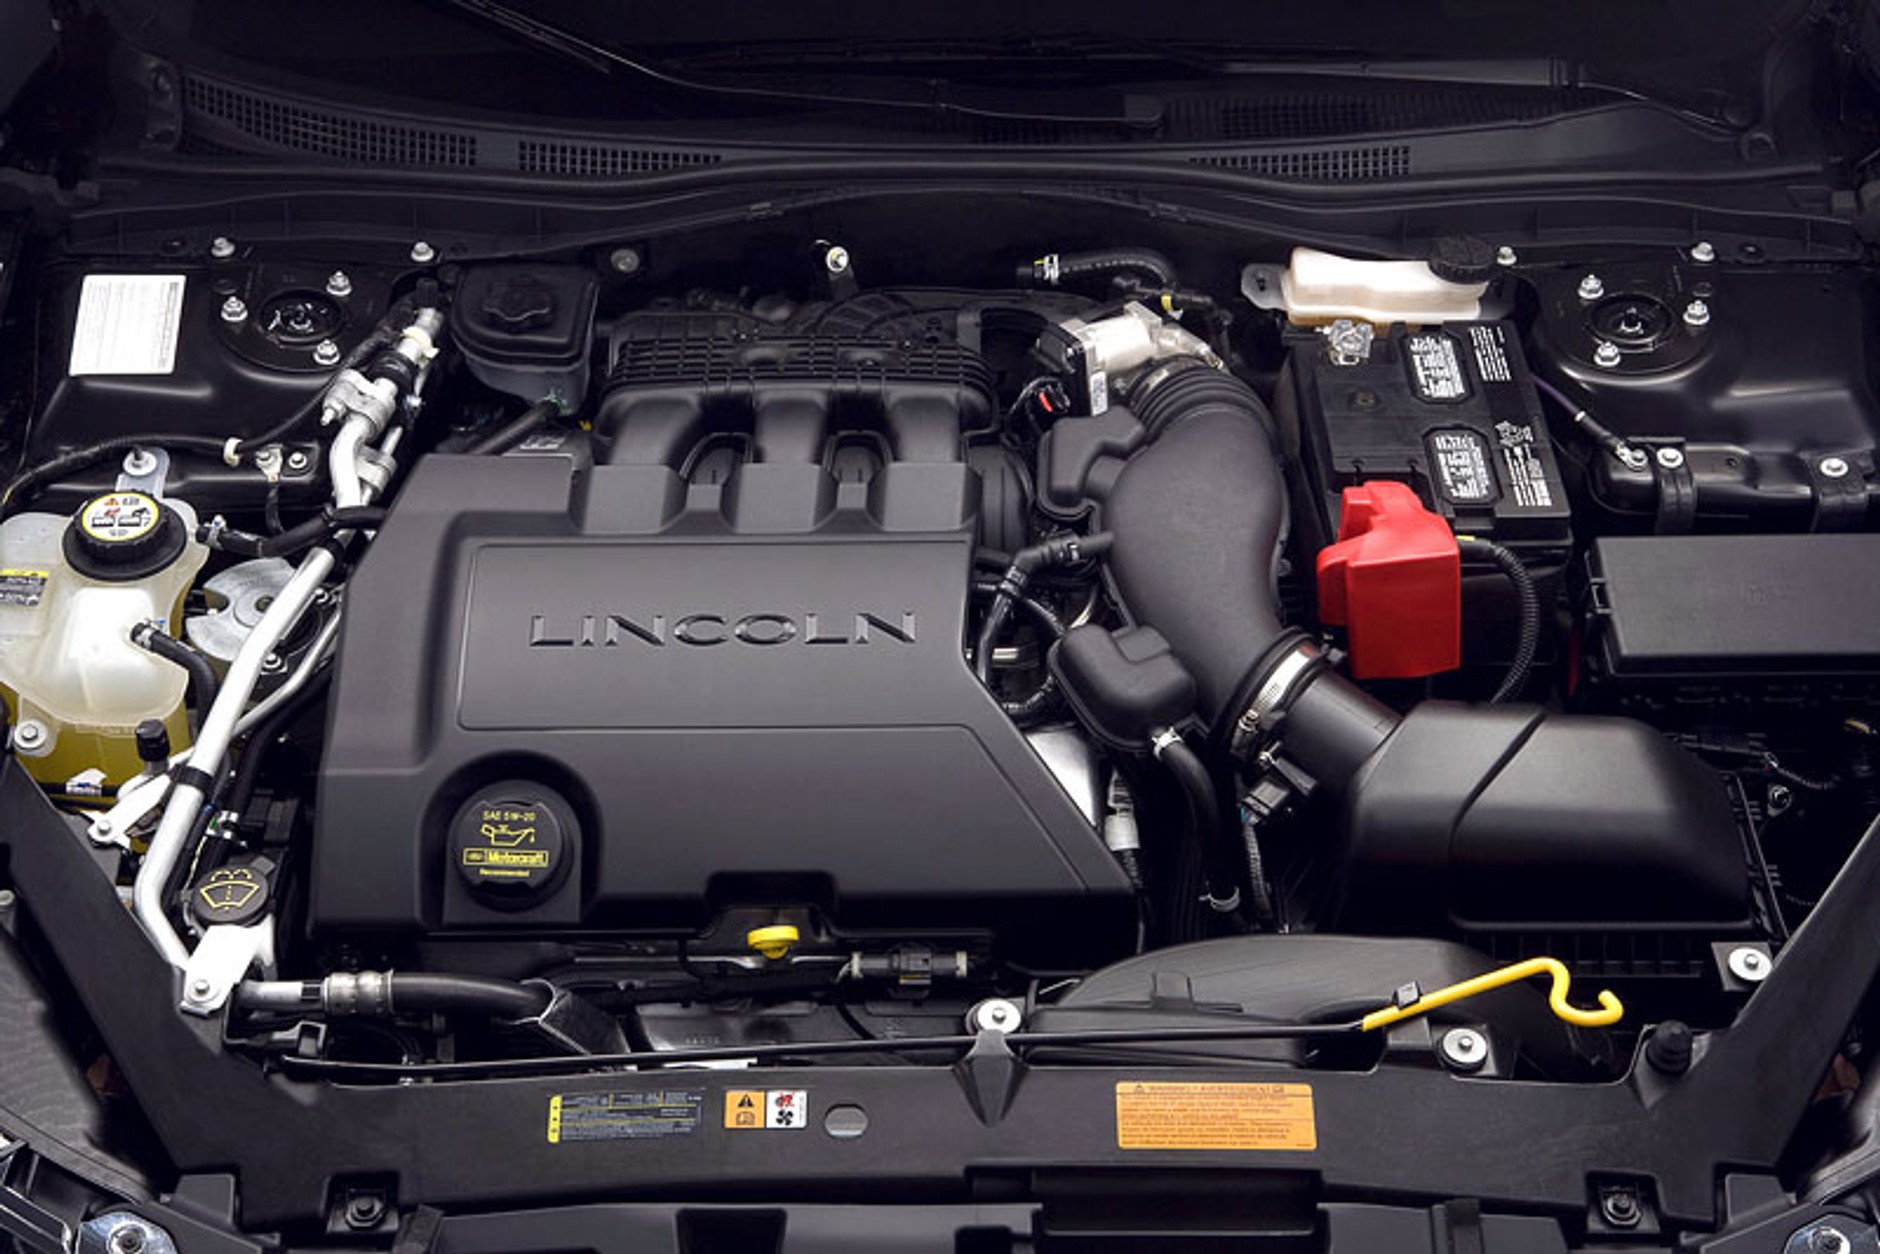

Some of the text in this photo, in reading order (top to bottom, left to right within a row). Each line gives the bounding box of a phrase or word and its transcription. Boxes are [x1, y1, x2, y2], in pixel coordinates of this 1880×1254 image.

[530, 612, 917, 647] LINCOLN
[483, 810, 536, 822] SAE 5W-20
